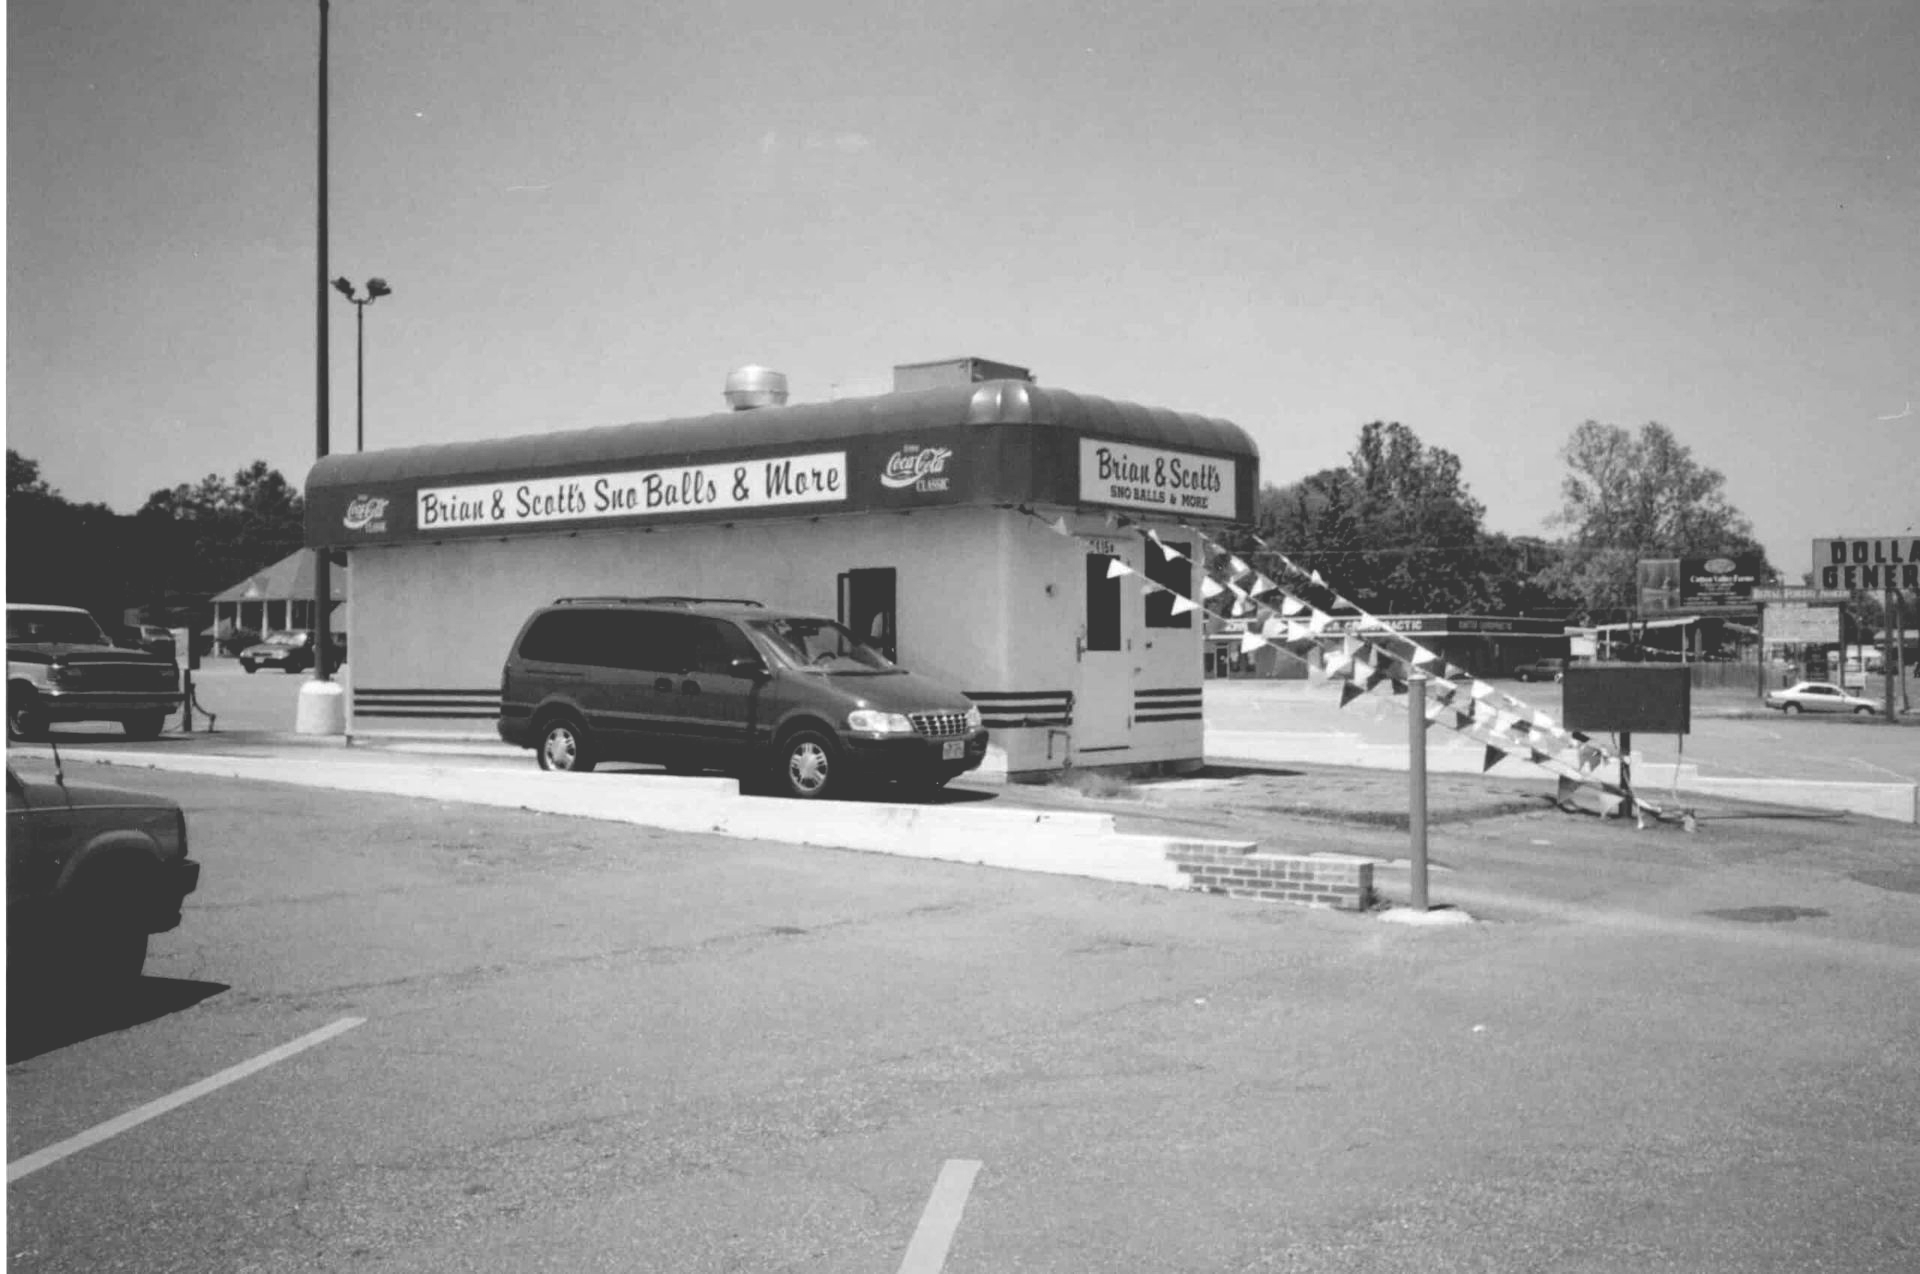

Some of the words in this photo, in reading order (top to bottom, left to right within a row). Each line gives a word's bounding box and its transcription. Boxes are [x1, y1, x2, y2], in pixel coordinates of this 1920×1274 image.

[1096, 447, 1151, 484] Brian
[1154, 457, 1167, 487] &
[1169, 458, 1221, 492] Scott's
[421, 493, 484, 525] Brian
[490, 489, 505, 521] &
[516, 484, 586, 518] Scott's
[594, 478, 638, 512] Sno
[642, 470, 717, 508] Balls
[732, 467, 750, 500] &
[765, 460, 840, 499] More
[1110, 485, 1132, 500] SNO
[1133, 488, 1166, 504] BALLS
[1169, 492, 1177, 505] &
[1181, 493, 1209, 509] MORE
